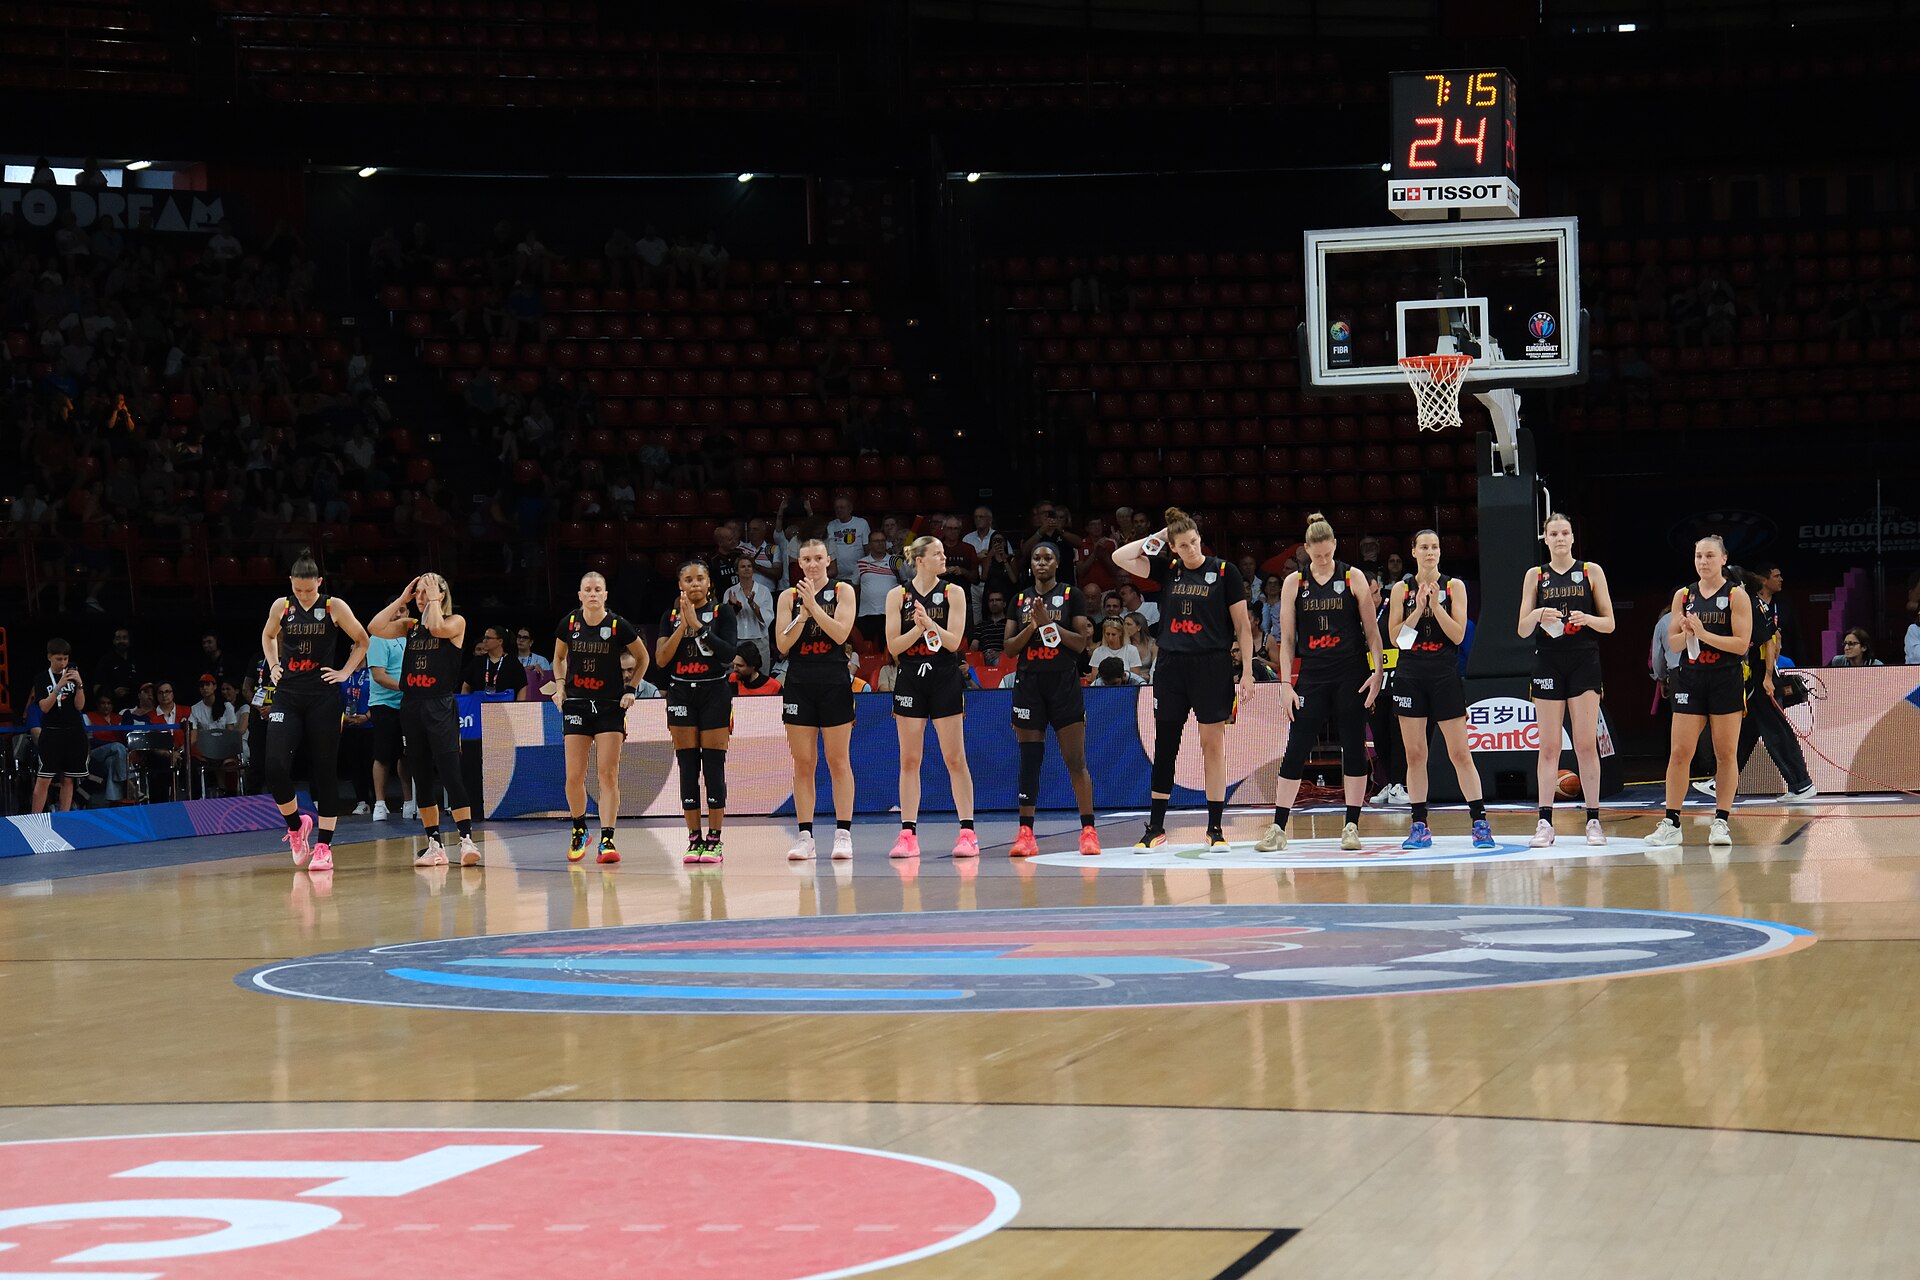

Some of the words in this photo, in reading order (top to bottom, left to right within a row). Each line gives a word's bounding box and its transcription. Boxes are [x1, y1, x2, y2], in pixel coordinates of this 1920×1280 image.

[1408, 117, 1487, 168] 24
[1423, 185, 1502, 201] TISSOT
[69, 190, 226, 232] DREAM
[1333, 345, 1349, 354] FIBA
[1798, 521, 1920, 539] EUROBAS
[1171, 584, 1210, 597] BELGIUM
[1542, 585, 1585, 600] BELGIUM
[1180, 600, 1193, 616] 13
[1302, 598, 1343, 612] BELGIUM
[287, 623, 326, 635] BELGIUM
[1169, 617, 1204, 635] lotto
[572, 640, 610, 655] BELGIUM
[799, 640, 833, 656] lotto
[1308, 634, 1342, 650] lotto
[1411, 641, 1445, 652] otto
[1026, 645, 1061, 661] lotto
[287, 656, 320, 672] lotto
[675, 661, 711, 676] lotto
[406, 672, 438, 689] lotto
[573, 673, 606, 691] lotto
[1470, 705, 1537, 724] 百岁山
[1466, 723, 1540, 750] Gante
